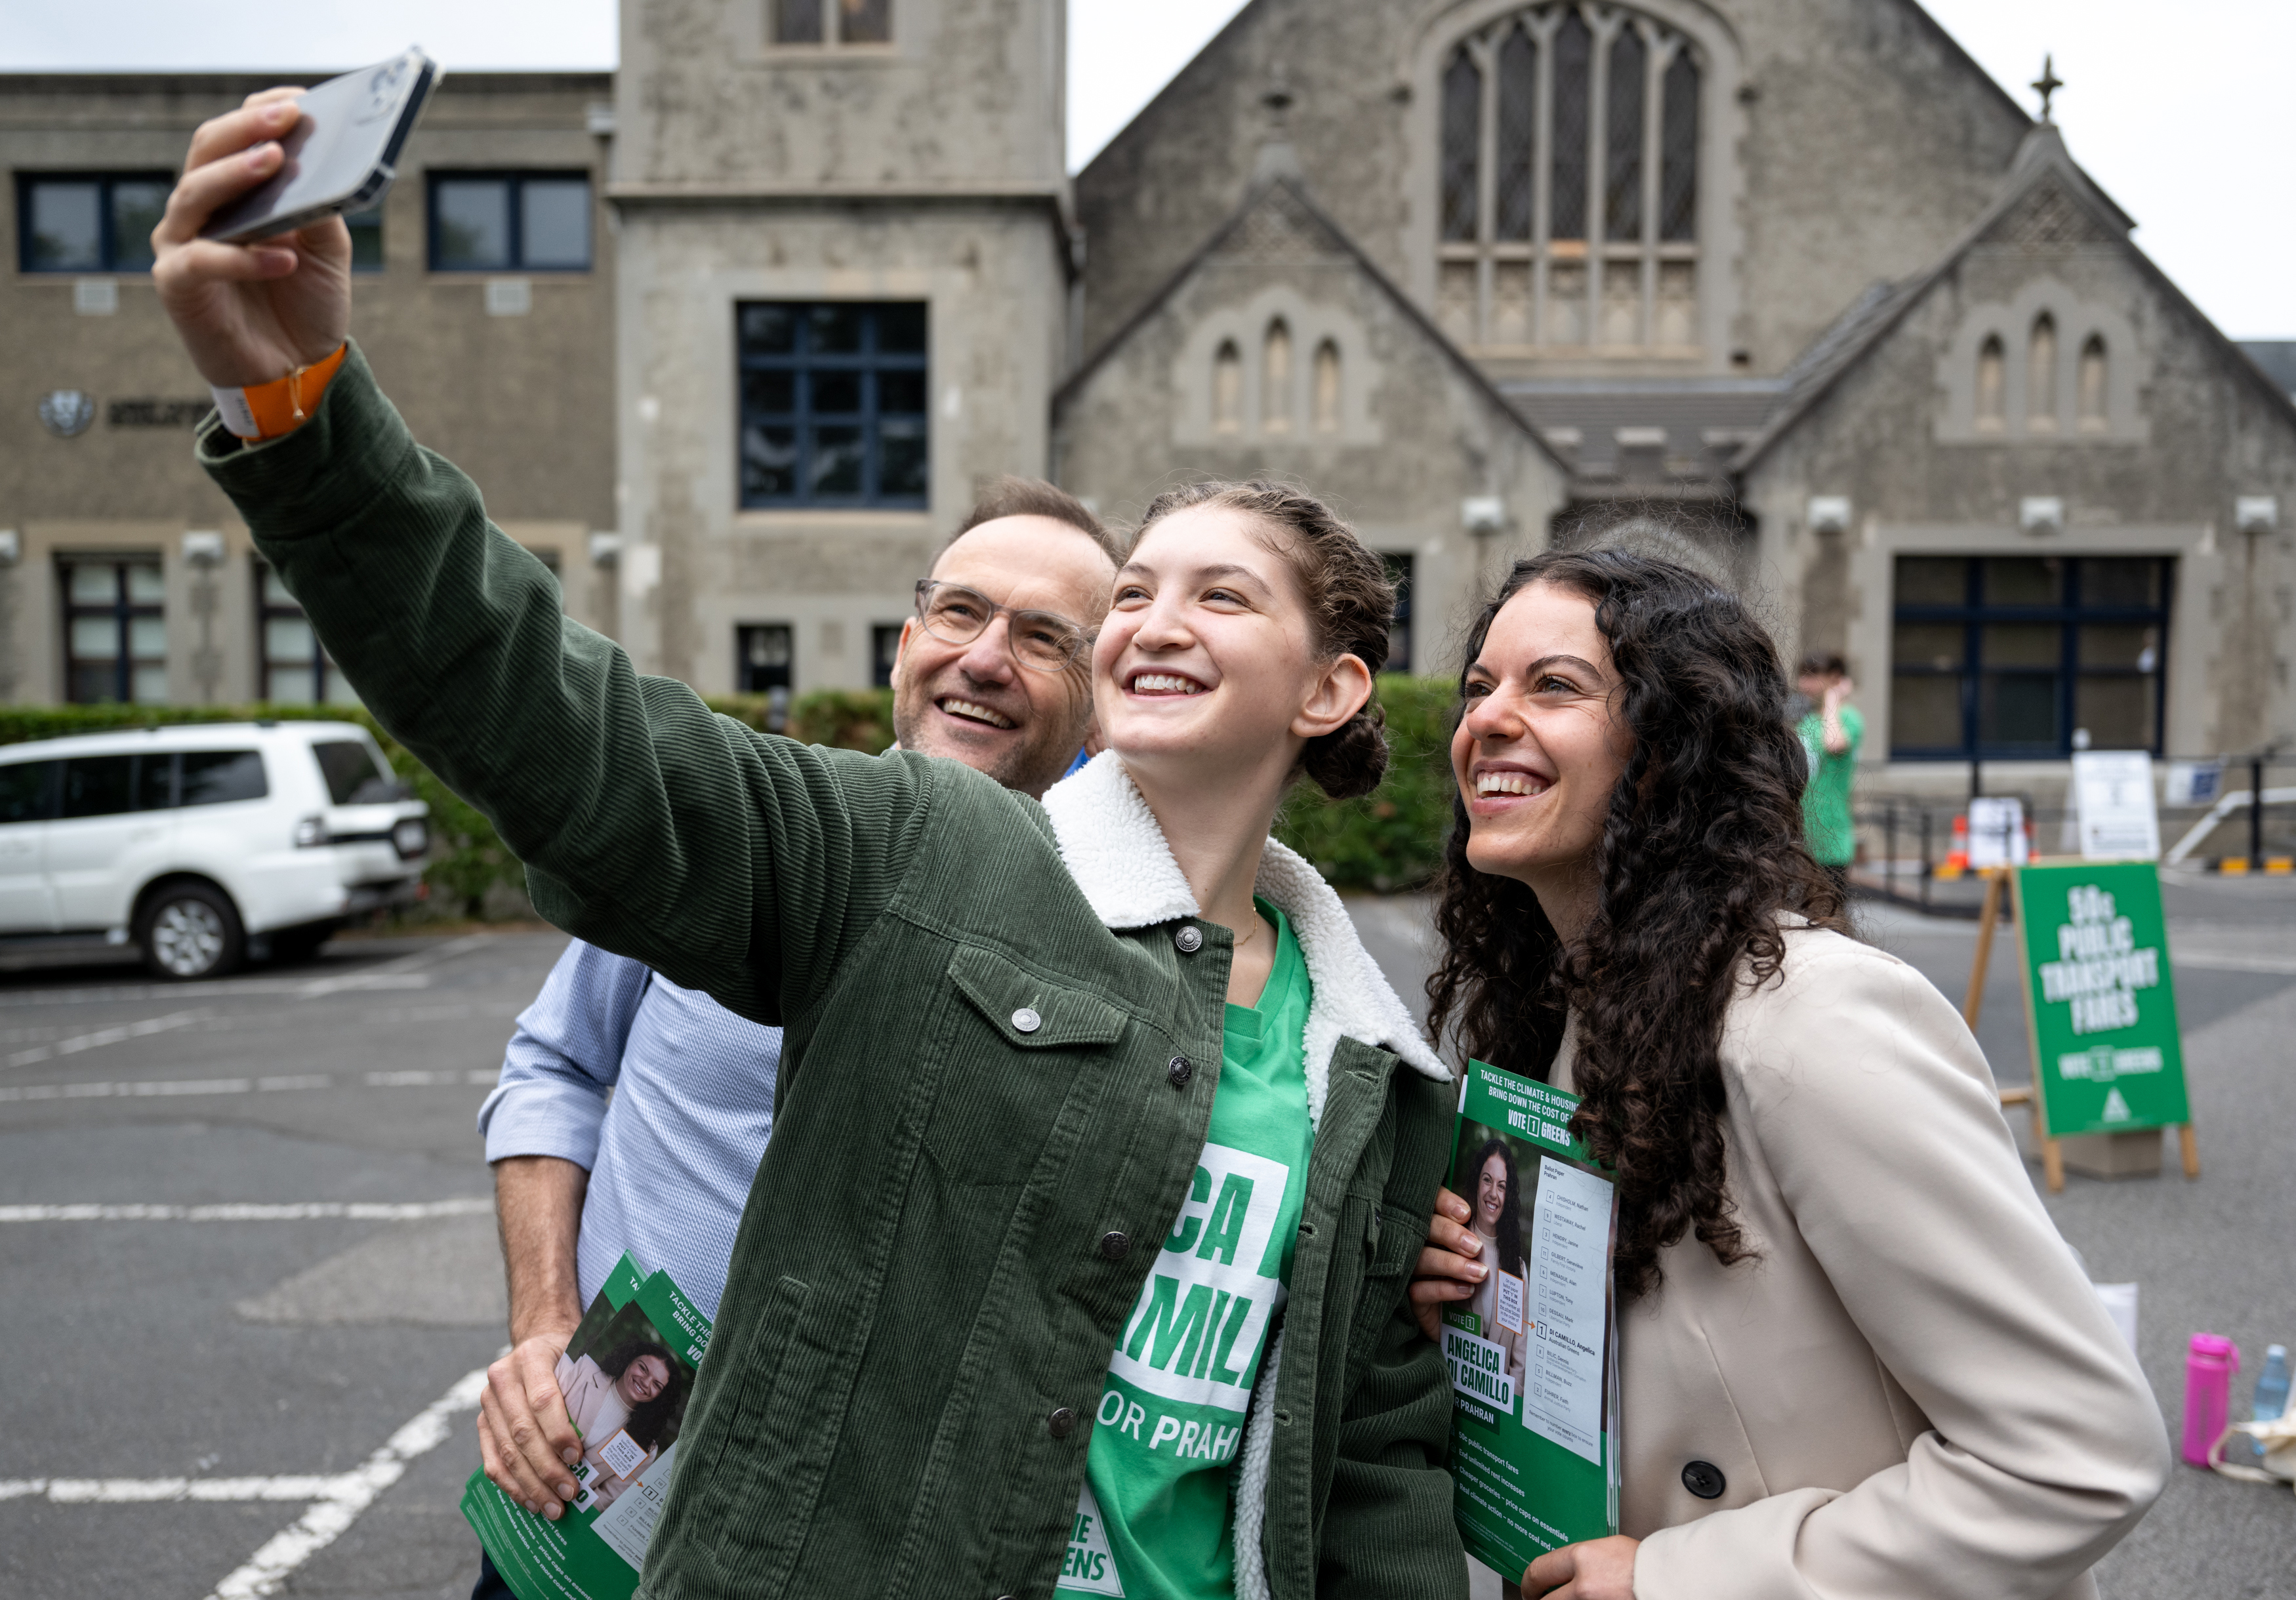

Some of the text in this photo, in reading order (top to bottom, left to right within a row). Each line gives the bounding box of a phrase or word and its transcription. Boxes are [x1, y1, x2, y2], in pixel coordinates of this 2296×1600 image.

[2057, 916, 2135, 961] PUBLIC
[2038, 947, 2160, 1004] TRANSPORT
[2070, 989, 2139, 1035] FARES
[1481, 1069, 1502, 1086] TACKLE
[1504, 1078, 1515, 1090] THE
[1517, 1082, 1544, 1101] CLIMATE
[1546, 1093, 1549, 1103] &
[1488, 1086, 1569, 1123] BRING DOWN THE COST OF
[1508, 1109, 1526, 1130] VOTE
[1542, 1122, 1570, 1147] GREENS
[1544, 1171, 1557, 1180] Prahran
[1557, 1195, 1576, 1207] CHISHOLM,
[1576, 1203, 1588, 1212] Nathan
[1555, 1214, 1574, 1227] WESTAWAY,
[1553, 1233, 1567, 1244] HENDRY,
[1551, 1252, 1566, 1263] GILBERT,
[1550, 1271, 1568, 1283] MENADUE,
[1506, 1302, 1517, 1311] number
[1549, 1289, 1565, 1301] LUPTON,
[669, 1291, 712, 1338] TACKLE THE
[672, 1311, 696, 1337] BRING
[1449, 1311, 1465, 1325] VOTE
[1549, 1308, 1565, 1320] DESSAU,
[1447, 1333, 1499, 1376] ANGELICA
[1549, 1337, 1579, 1355] Australian Greens
[1555, 1332, 1576, 1347] CAMILLO,
[1577, 1342, 1595, 1356] Angelica
[1547, 1350, 1557, 1359] BILIC,
[1557, 1355, 1569, 1364] Dennis
[1447, 1357, 1509, 1405] DI CAMILLO
[1546, 1370, 1563, 1383] BILLMAN,
[1544, 1389, 1559, 1401] FUHRER,
[1461, 1399, 1494, 1424] PRAHRAN
[1529, 1410, 1546, 1422] Remember
[1549, 1422, 1561, 1430] number
[1459, 1431, 1519, 1475] 50c public transport fares
[1459, 1448, 1525, 1497] End unlimited rent increases
[1460, 1466, 1568, 1542] Cheaper groceries price caps on essentials
[1460, 1483, 1551, 1551] Real climate action no more coal and
[497, 1489, 506, 1505] Real
[504, 1505, 518, 1530] climate
[516, 1530, 530, 1549] action
[533, 1555, 540, 1564] no
[539, 1563, 553, 1580] more
[553, 1579, 565, 1592] coal
[516, 1510, 536, 1540] groceries
[539, 1546, 552, 1561] price
[552, 1561, 564, 1575] caps
[533, 1519, 543, 1532] rent
[543, 1531, 565, 1560] increases
[554, 1529, 567, 1546] fares
